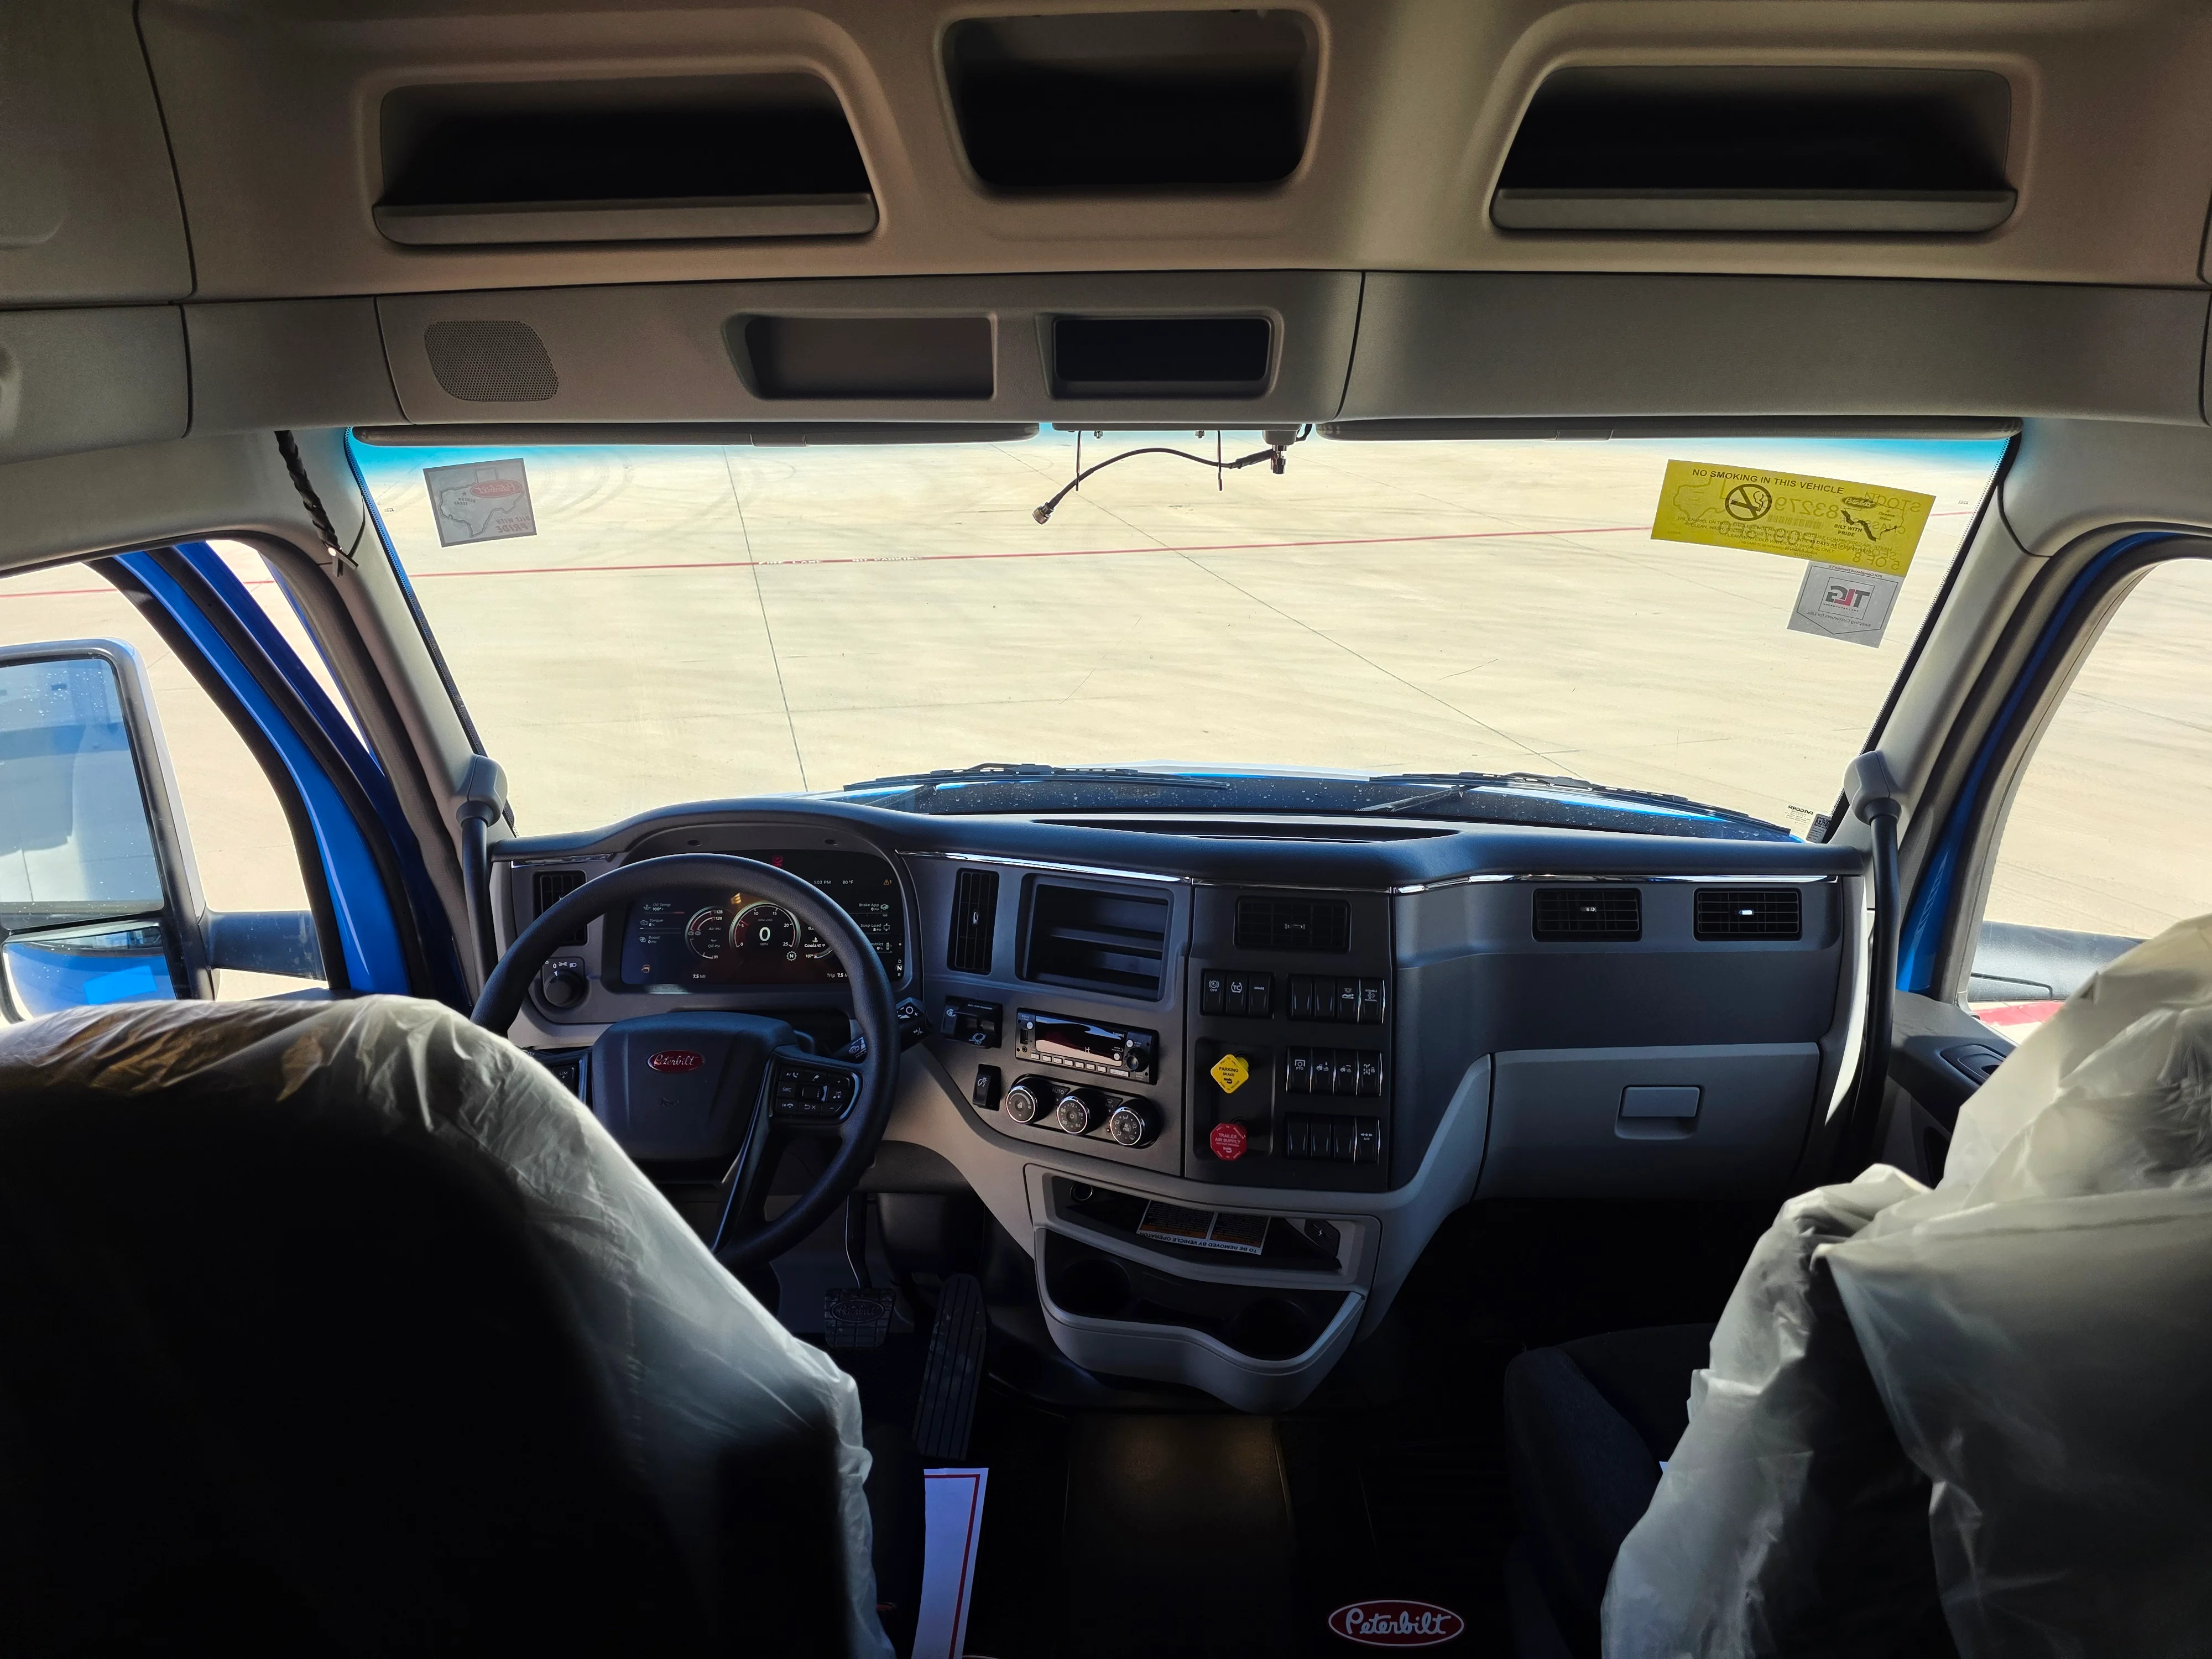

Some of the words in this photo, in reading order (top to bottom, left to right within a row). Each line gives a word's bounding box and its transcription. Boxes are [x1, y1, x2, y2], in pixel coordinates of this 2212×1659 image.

[1710, 471, 1757, 482] SMOKING
[1774, 478, 1796, 487] THIS
[1800, 481, 1844, 494] VEHICLE
[759, 927, 771, 942] 0
[654, 1054, 700, 1066] Peterbilt
[1345, 1608, 1452, 1635] Peterbilt
